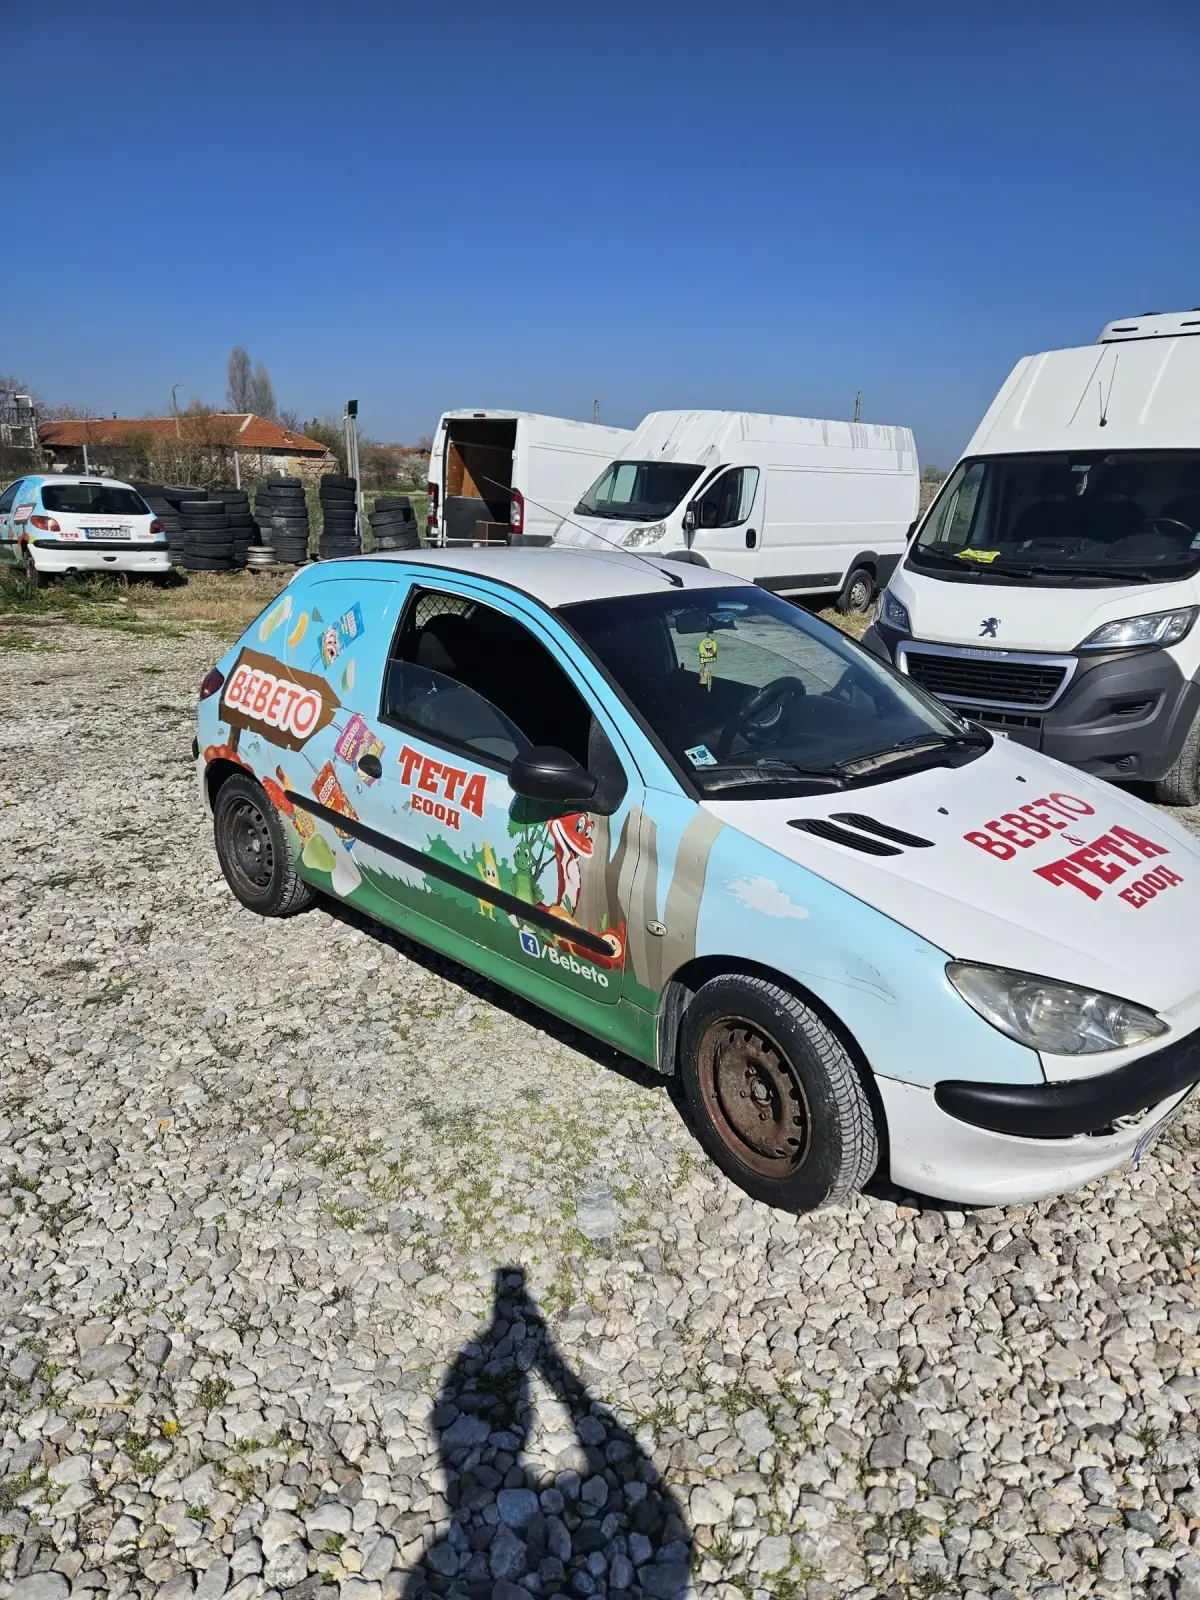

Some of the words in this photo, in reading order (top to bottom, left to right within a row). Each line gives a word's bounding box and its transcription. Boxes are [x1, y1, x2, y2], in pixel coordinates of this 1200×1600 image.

[227, 669, 318, 734] BEBETO
[341, 723, 359, 755] BEBETO
[320, 776, 335, 804] BEBETO
[411, 793, 460, 831] ЕООД
[963, 793, 1095, 860] BEBETO
[1061, 832, 1086, 846] &
[1118, 865, 1185, 909] ЕООД
